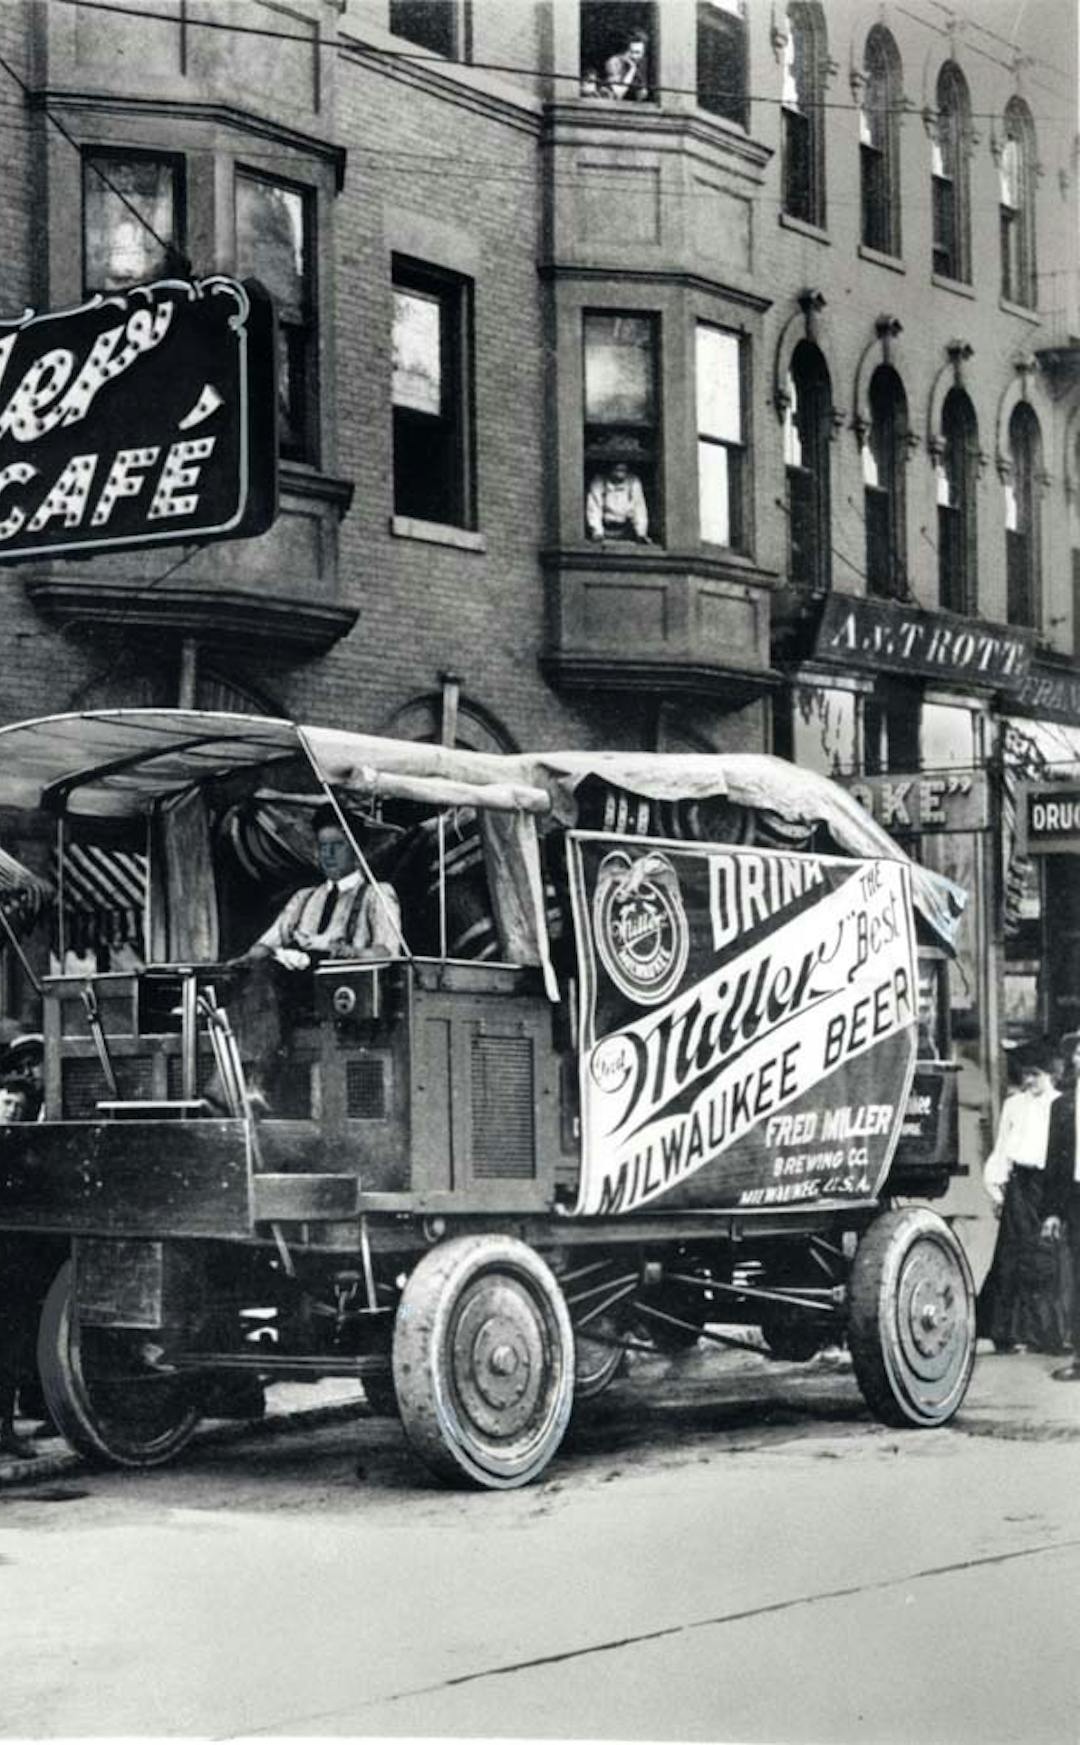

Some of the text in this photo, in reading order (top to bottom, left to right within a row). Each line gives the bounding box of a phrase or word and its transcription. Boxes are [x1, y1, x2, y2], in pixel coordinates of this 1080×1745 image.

[707, 854, 824, 952] DRINK
[591, 919, 844, 1135] Miller
[599, 967, 912, 1213] MILWAUKEE BEER
[766, 1113, 817, 1148] FRED
[822, 1104, 894, 1142] MILLER
[774, 1151, 844, 1177] BREWING
